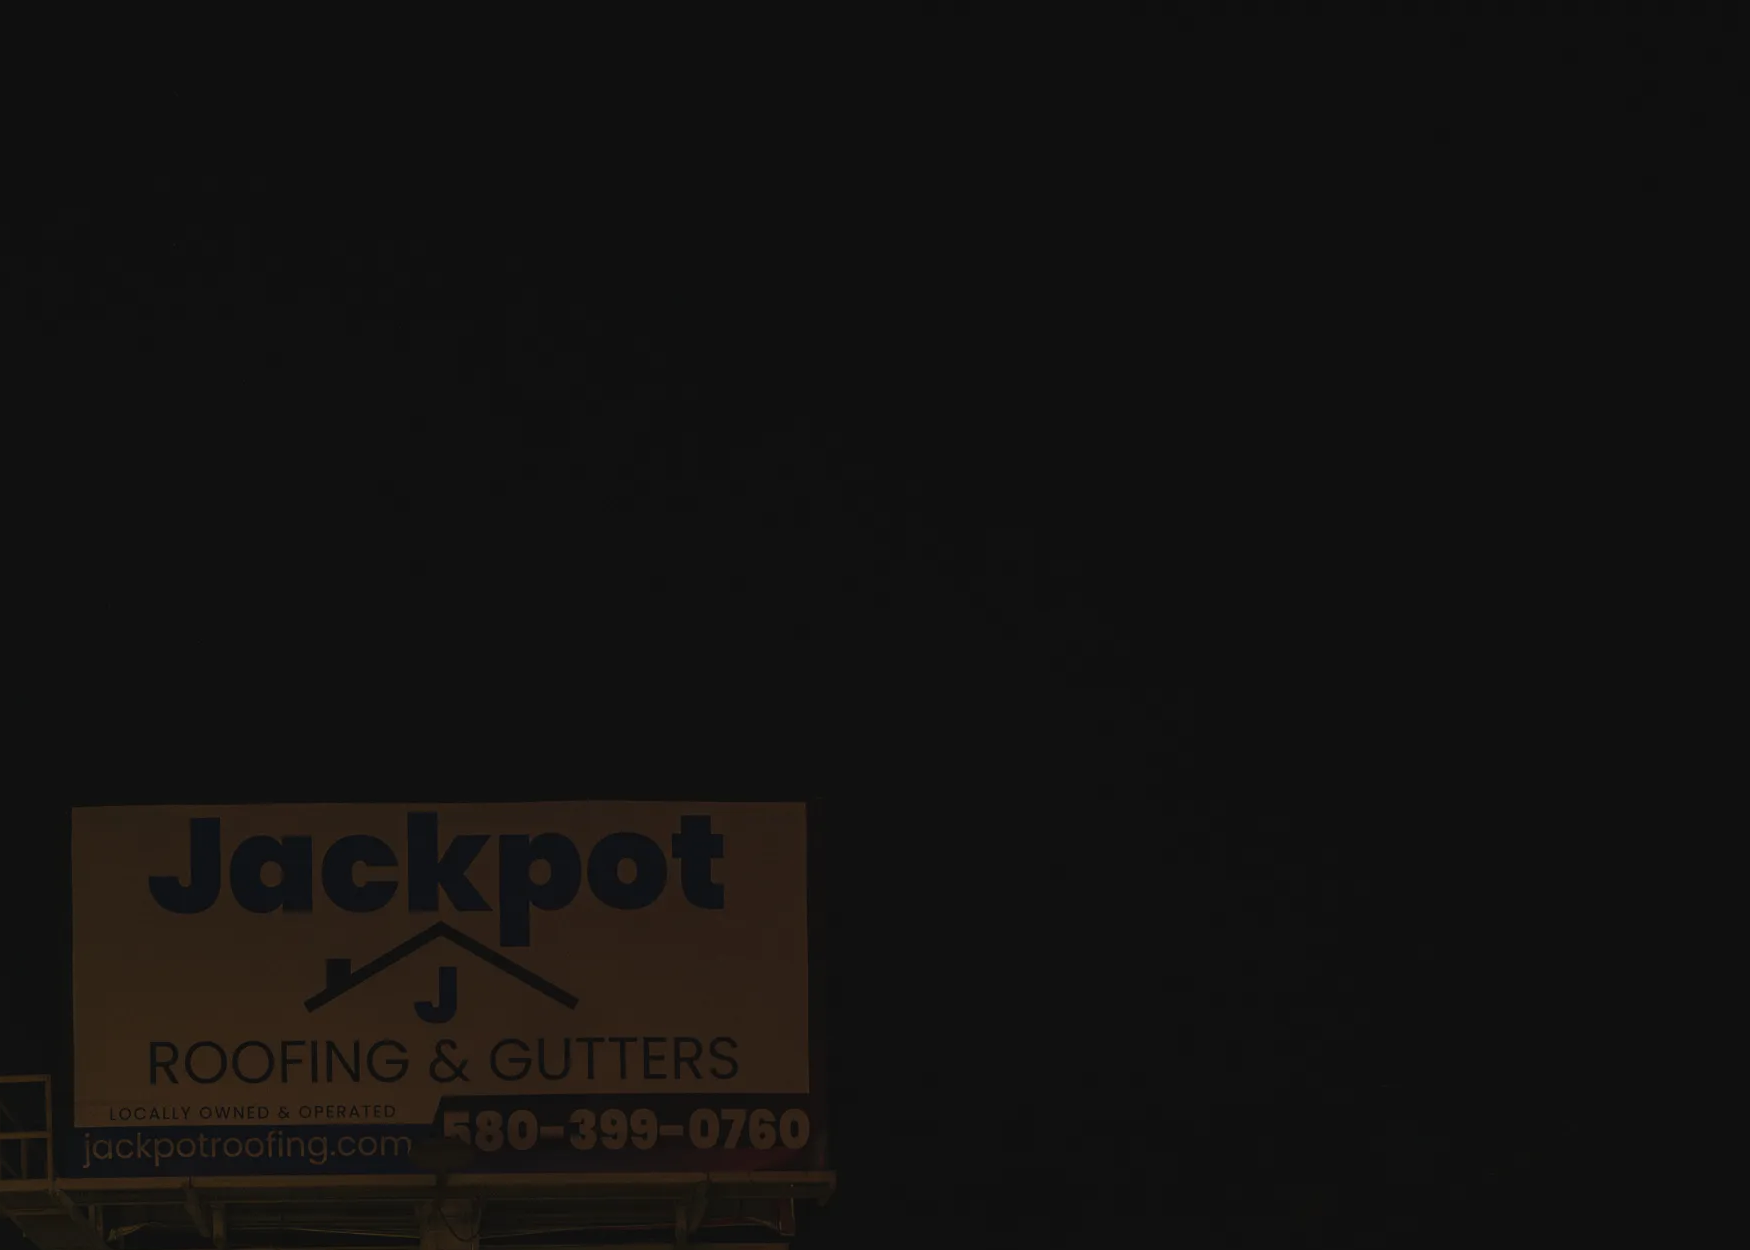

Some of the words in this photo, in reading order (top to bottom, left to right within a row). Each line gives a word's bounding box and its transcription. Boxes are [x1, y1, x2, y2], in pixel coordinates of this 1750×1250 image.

[149, 811, 724, 946] Jackpot
[414, 966, 457, 1023] J
[150, 1039, 408, 1085] ROOFING
[430, 1040, 468, 1082] &
[490, 1036, 739, 1082] GUTTERS
[110, 1106, 190, 1121] LOCALLY
[200, 1105, 269, 1120] OWNED
[278, 1105, 290, 1119] &
[299, 1105, 397, 1119] OPERATED
[443, 1108, 810, 1152] 580-399-0760
[82, 1130, 412, 1169] jackpotroofing.com
